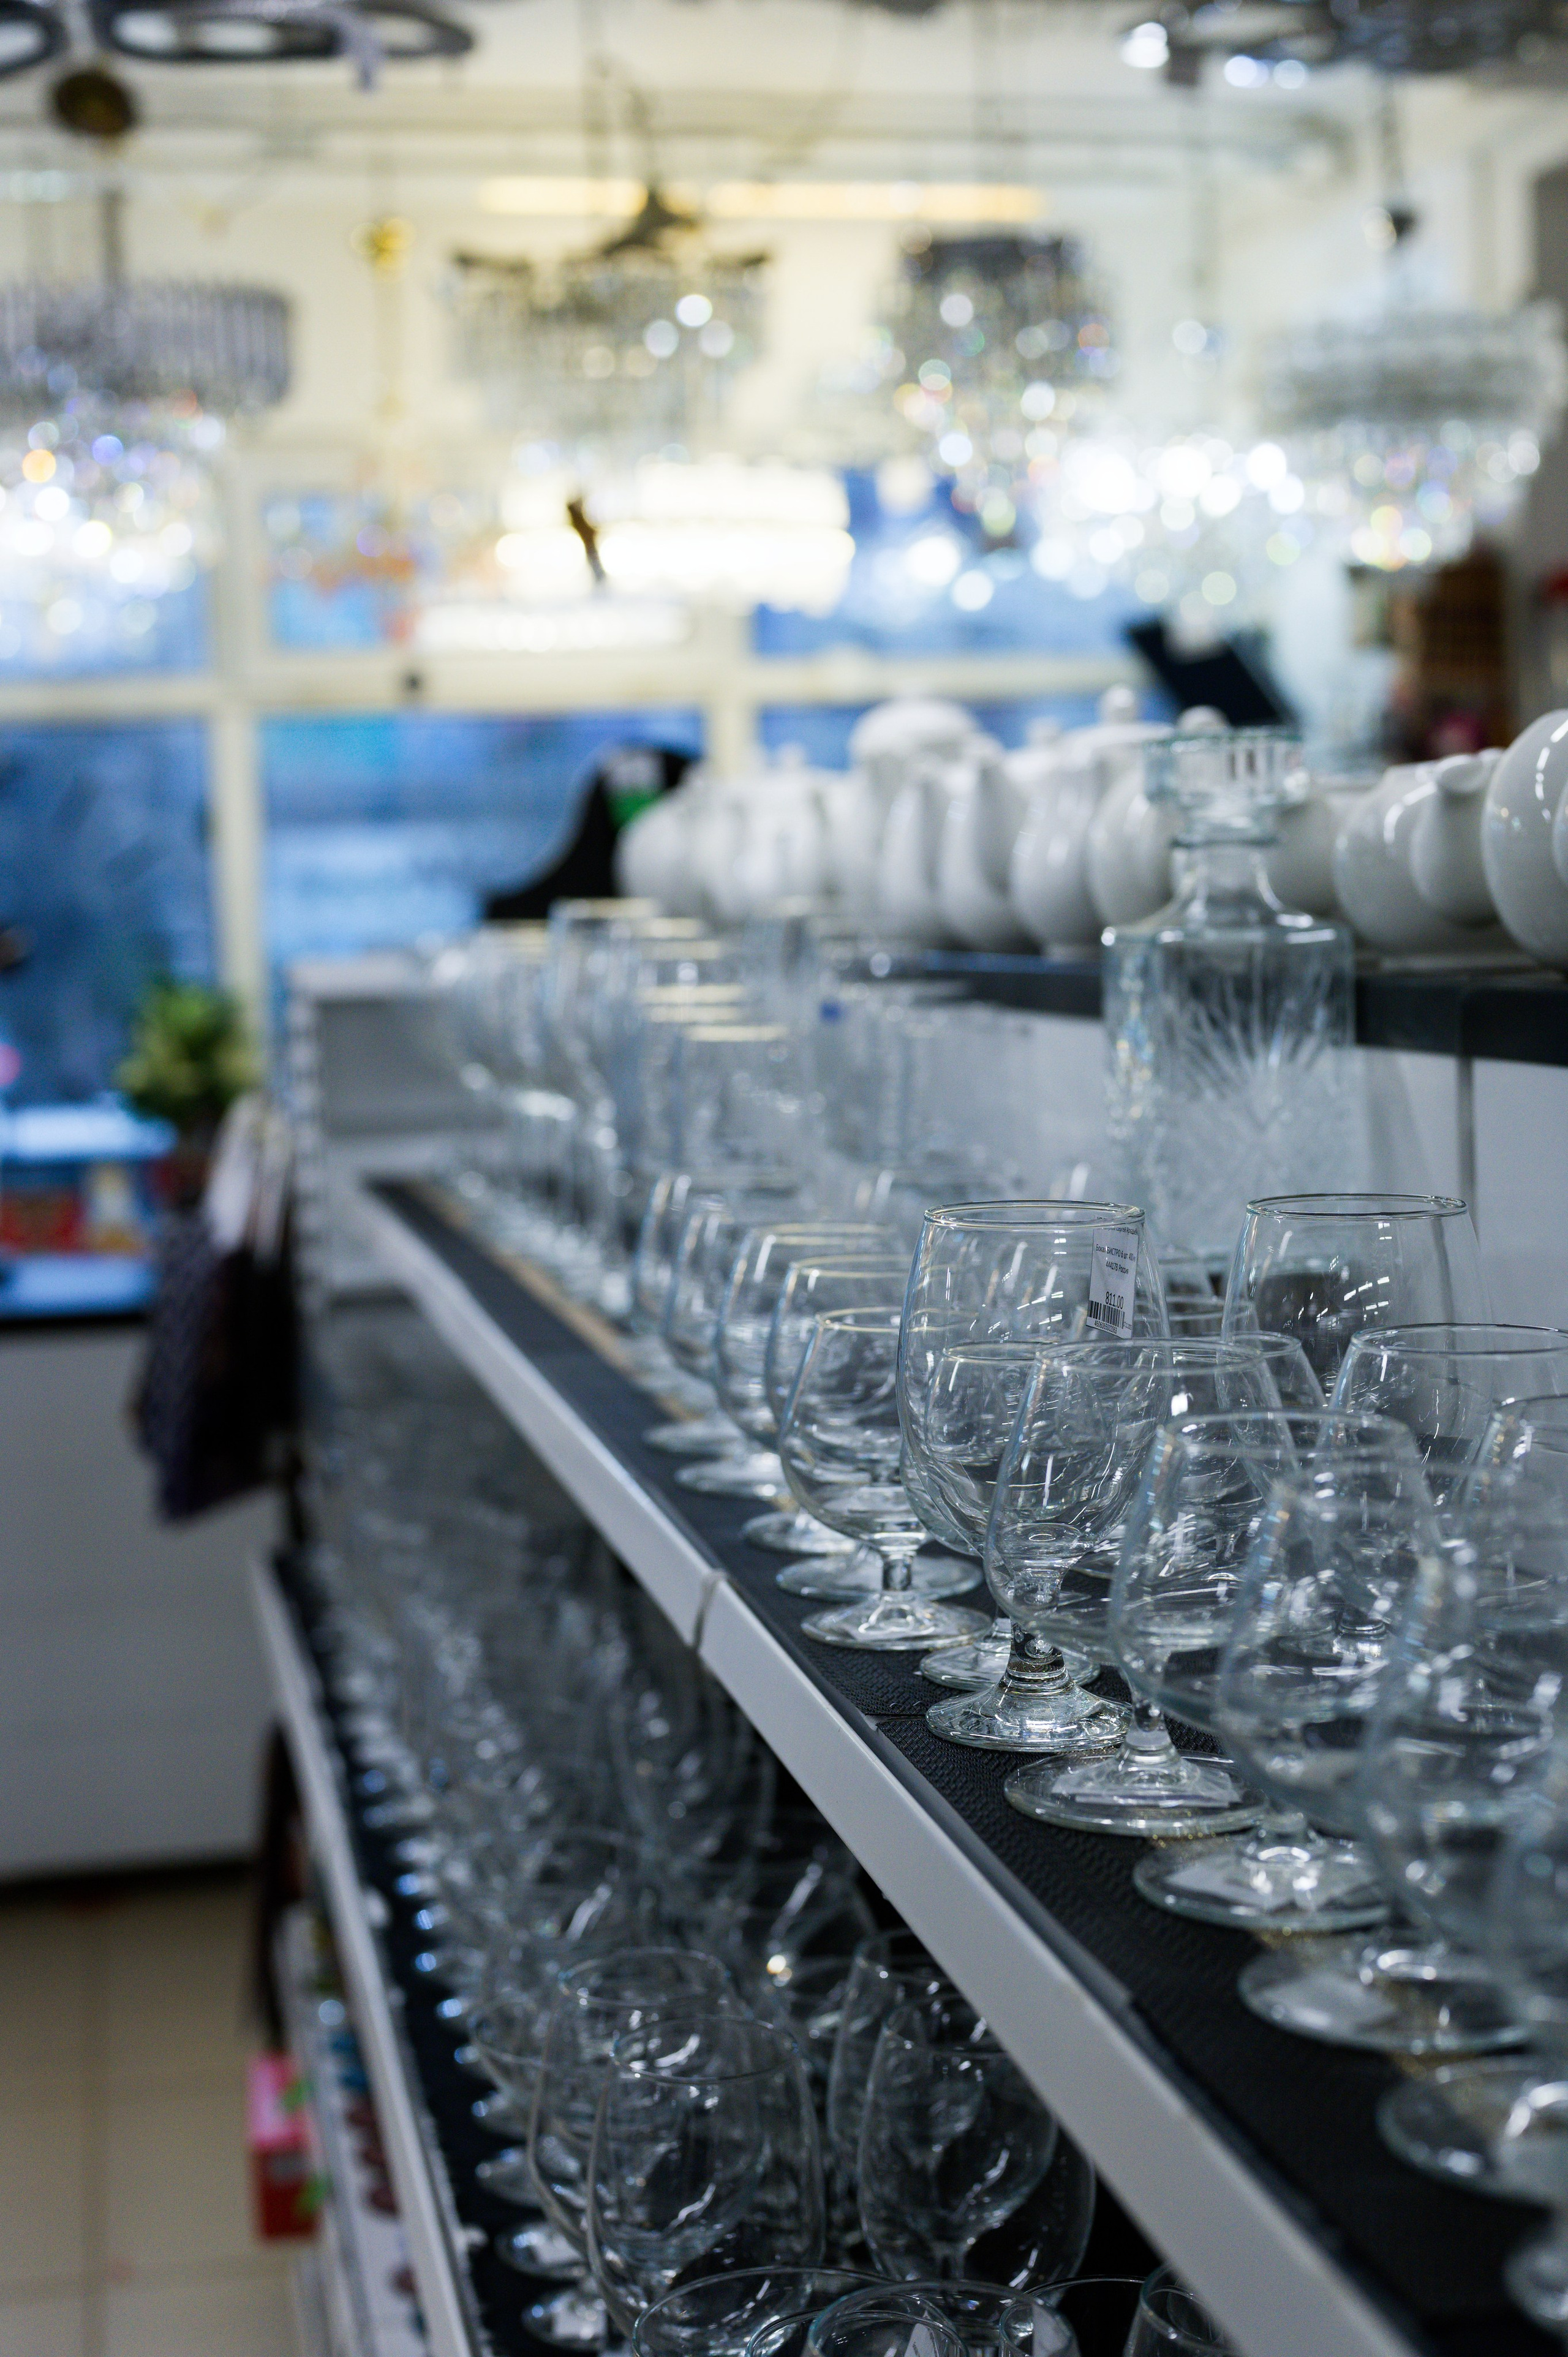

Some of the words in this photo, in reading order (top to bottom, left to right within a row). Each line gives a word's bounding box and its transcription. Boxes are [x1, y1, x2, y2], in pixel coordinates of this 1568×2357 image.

[1107, 1246, 1121, 1258] БИСТРО
[1118, 1264, 1129, 1274] Россия
[1106, 1291, 1124, 1310] 811.00
